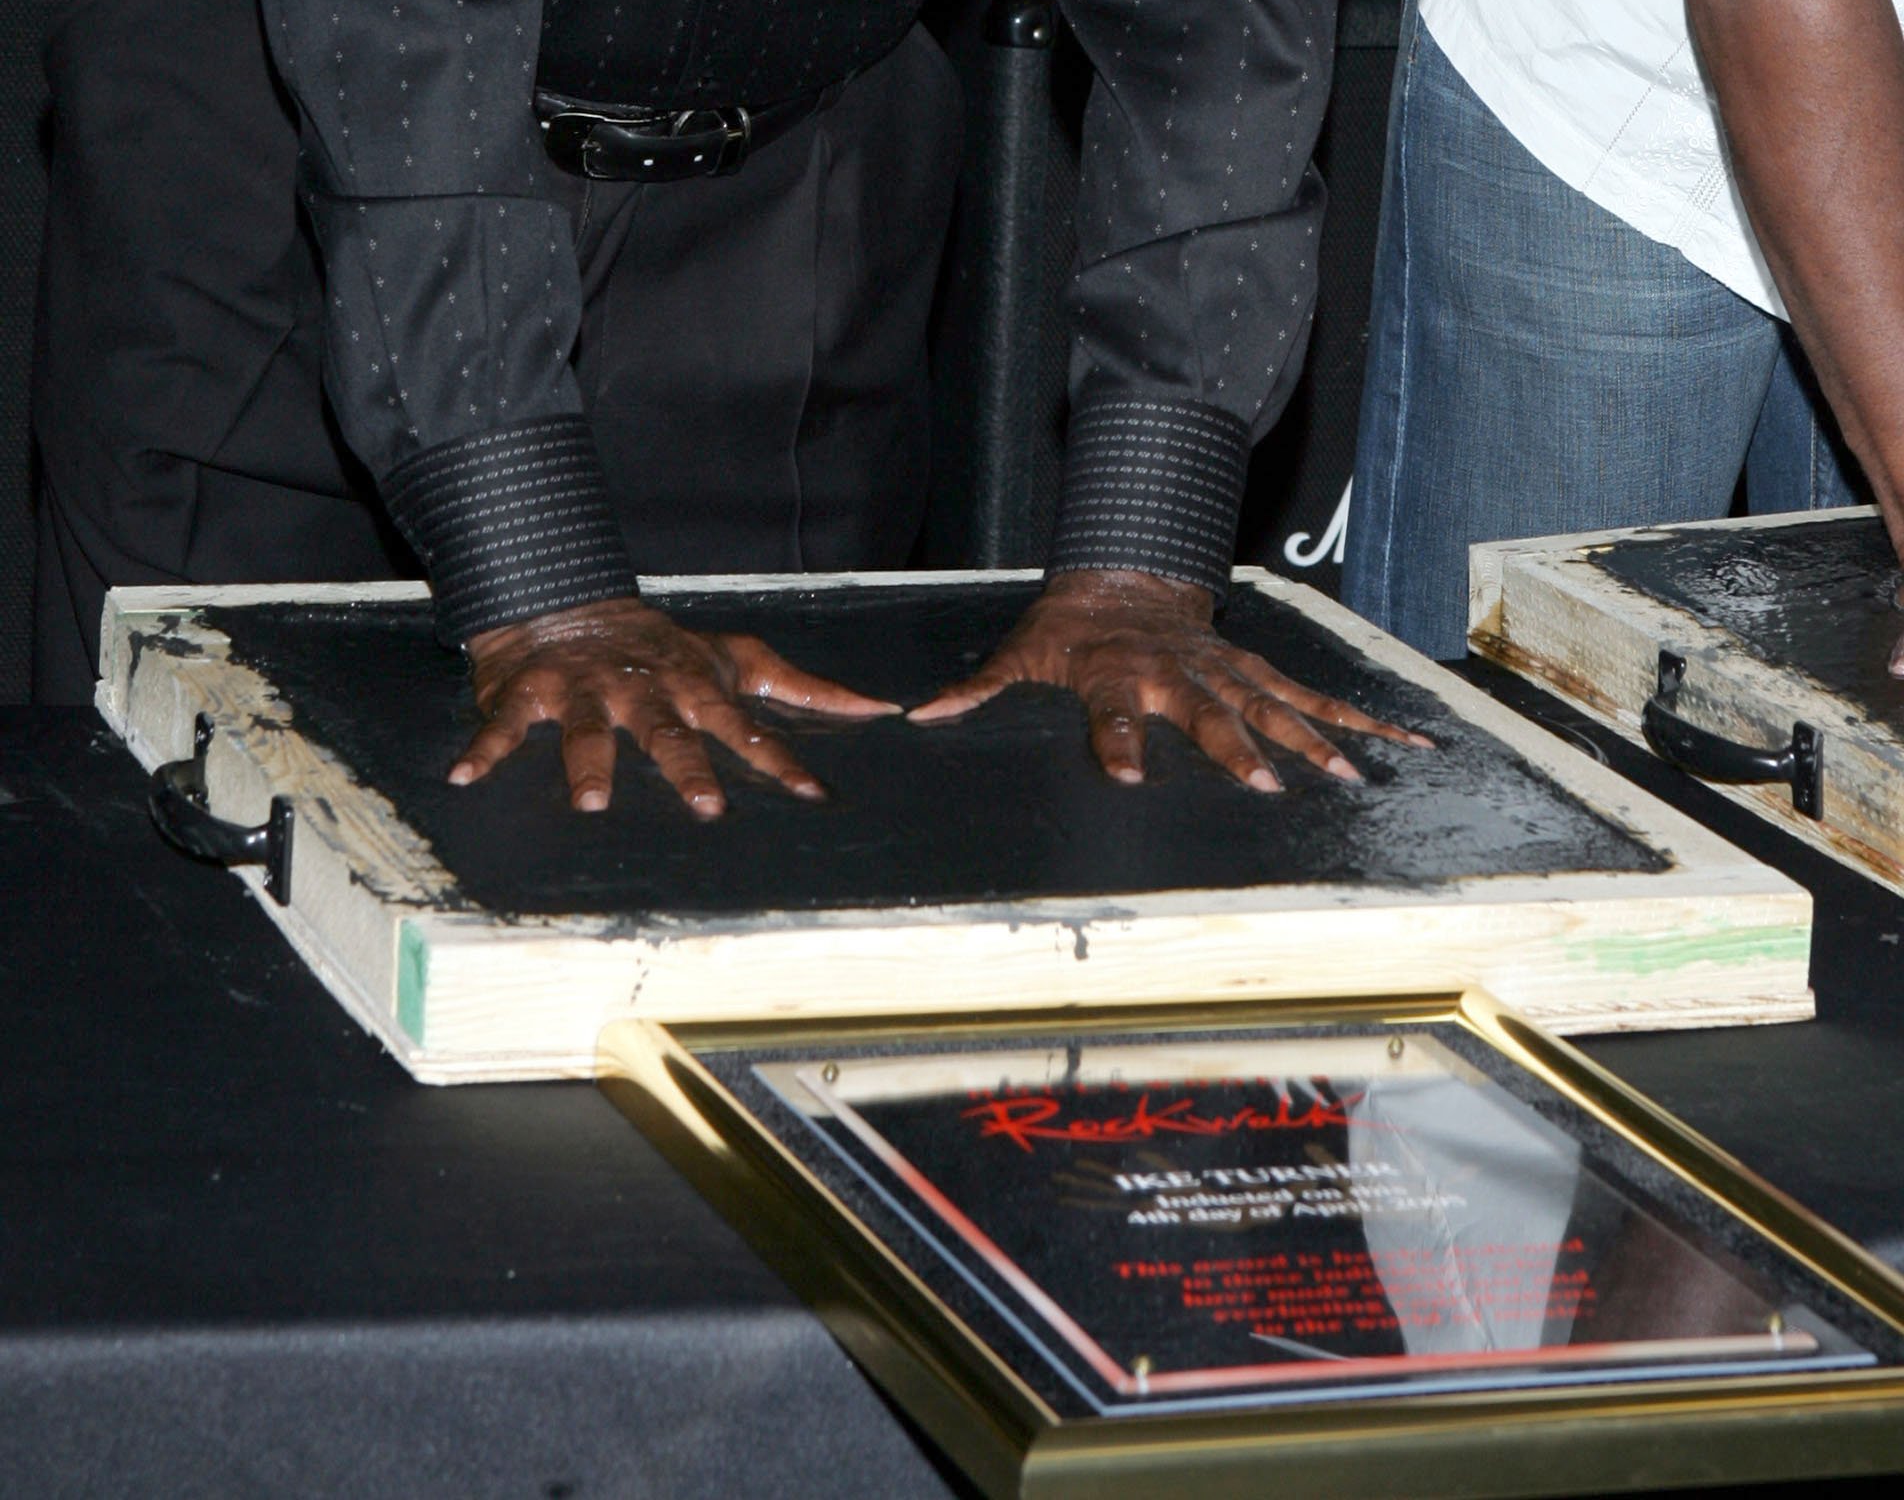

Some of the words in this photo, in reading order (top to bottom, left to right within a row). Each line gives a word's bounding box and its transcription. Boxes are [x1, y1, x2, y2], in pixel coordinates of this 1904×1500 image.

[1114, 1171, 1201, 1191] IKE
[1203, 1162, 1400, 1186] TURNER
[1156, 1187, 1295, 1209] Inducted
